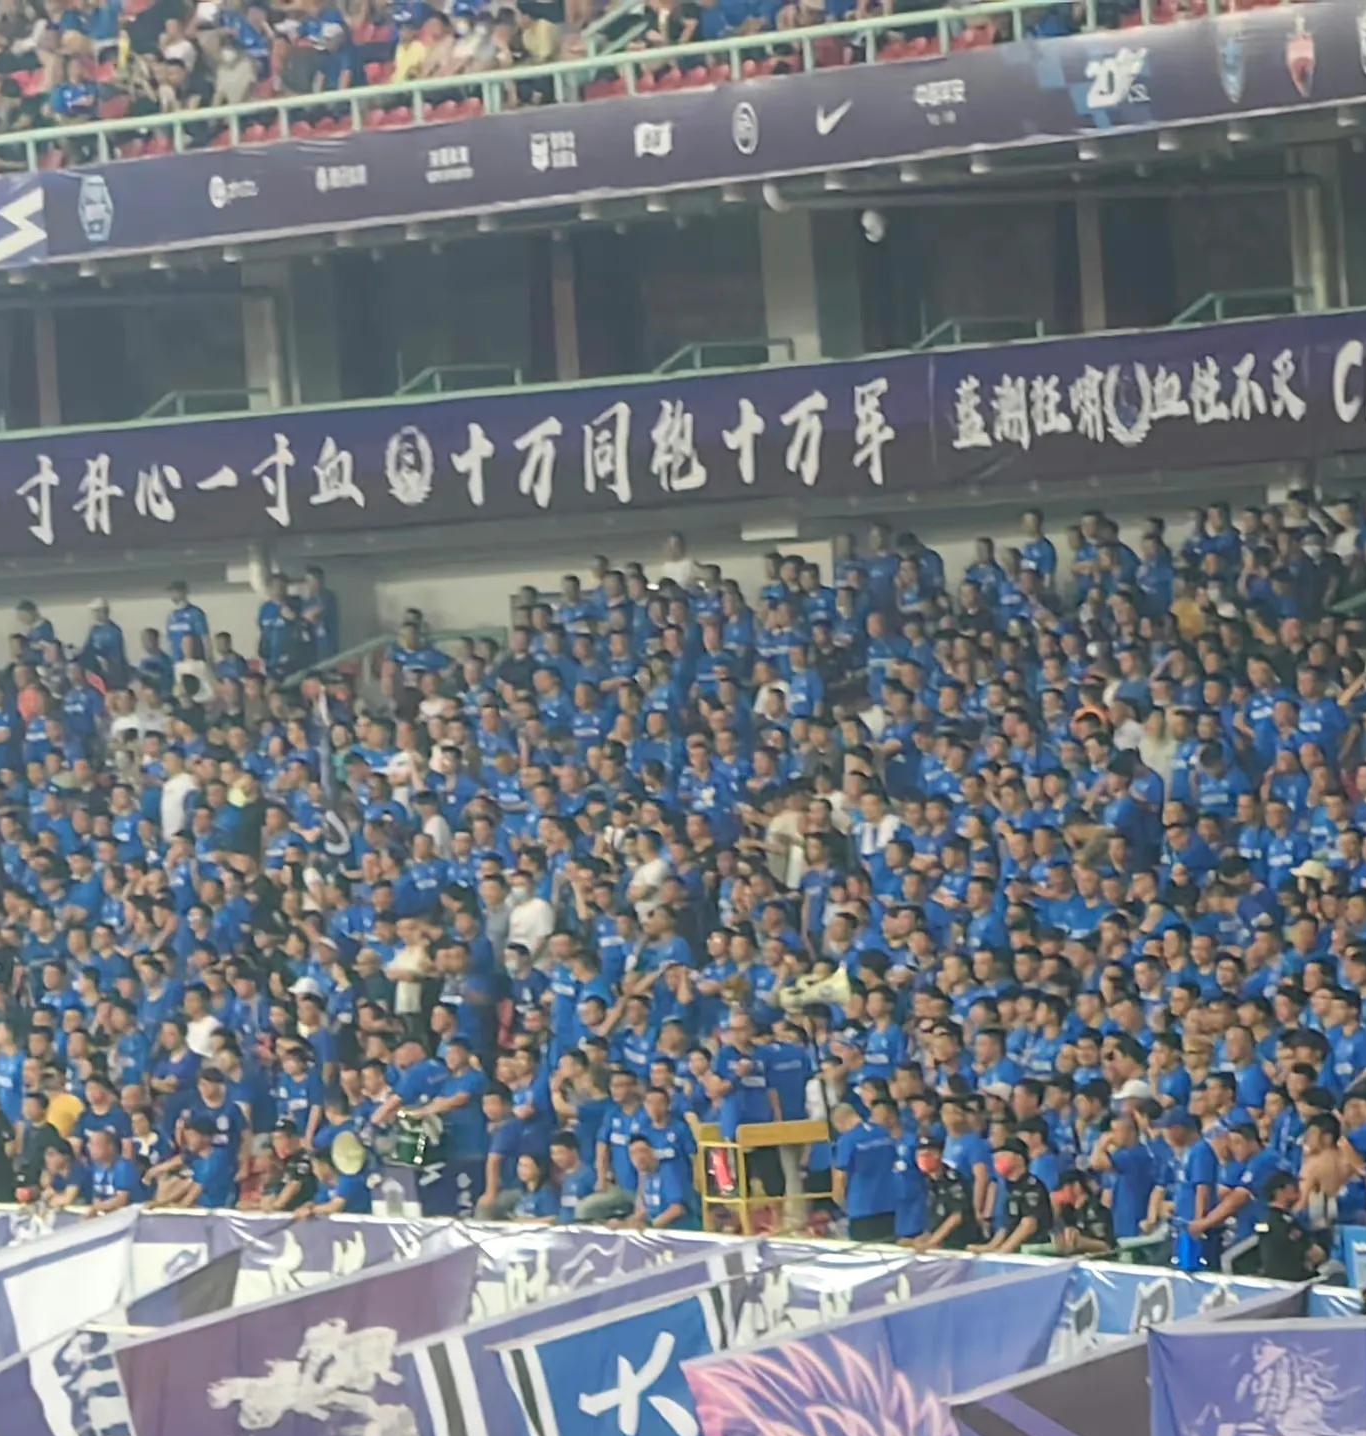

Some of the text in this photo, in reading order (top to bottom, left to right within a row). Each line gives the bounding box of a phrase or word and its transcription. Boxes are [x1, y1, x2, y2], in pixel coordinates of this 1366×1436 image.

[450, 376, 896, 509] 十万同袍十万军
